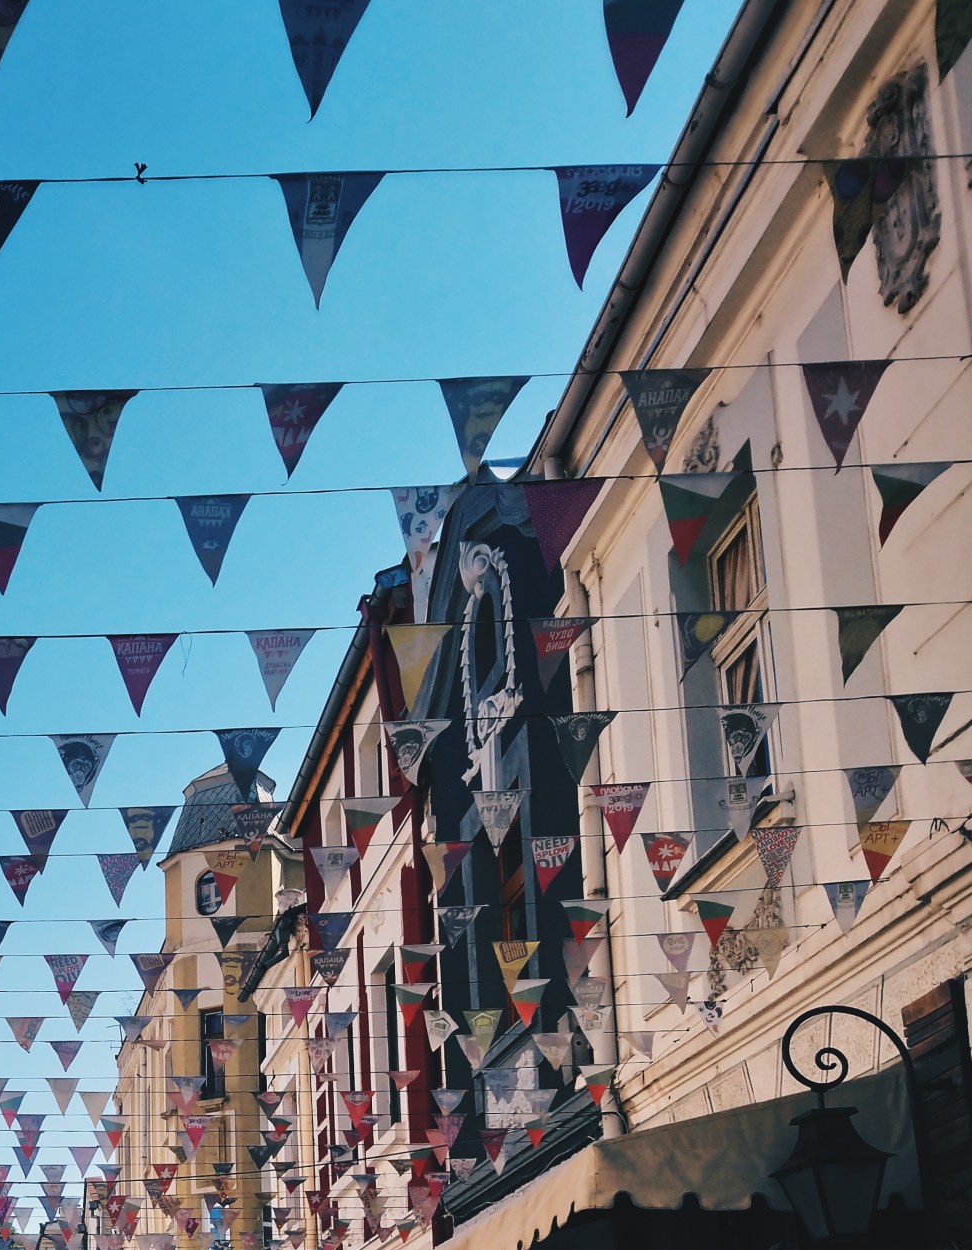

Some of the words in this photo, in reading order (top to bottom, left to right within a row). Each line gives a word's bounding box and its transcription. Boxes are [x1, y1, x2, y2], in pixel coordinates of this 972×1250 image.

[550, 628, 575, 640] ЧУДО
[257, 636, 300, 649] КАПАНА
[117, 641, 162, 656] КАПАНА
[237, 812, 275, 821] КАПАНА
[533, 837, 570, 851] NEED
[214, 860, 237, 870] АРТ
[50, 956, 78, 967] NEED
[314, 956, 345, 966] КАПАНА
